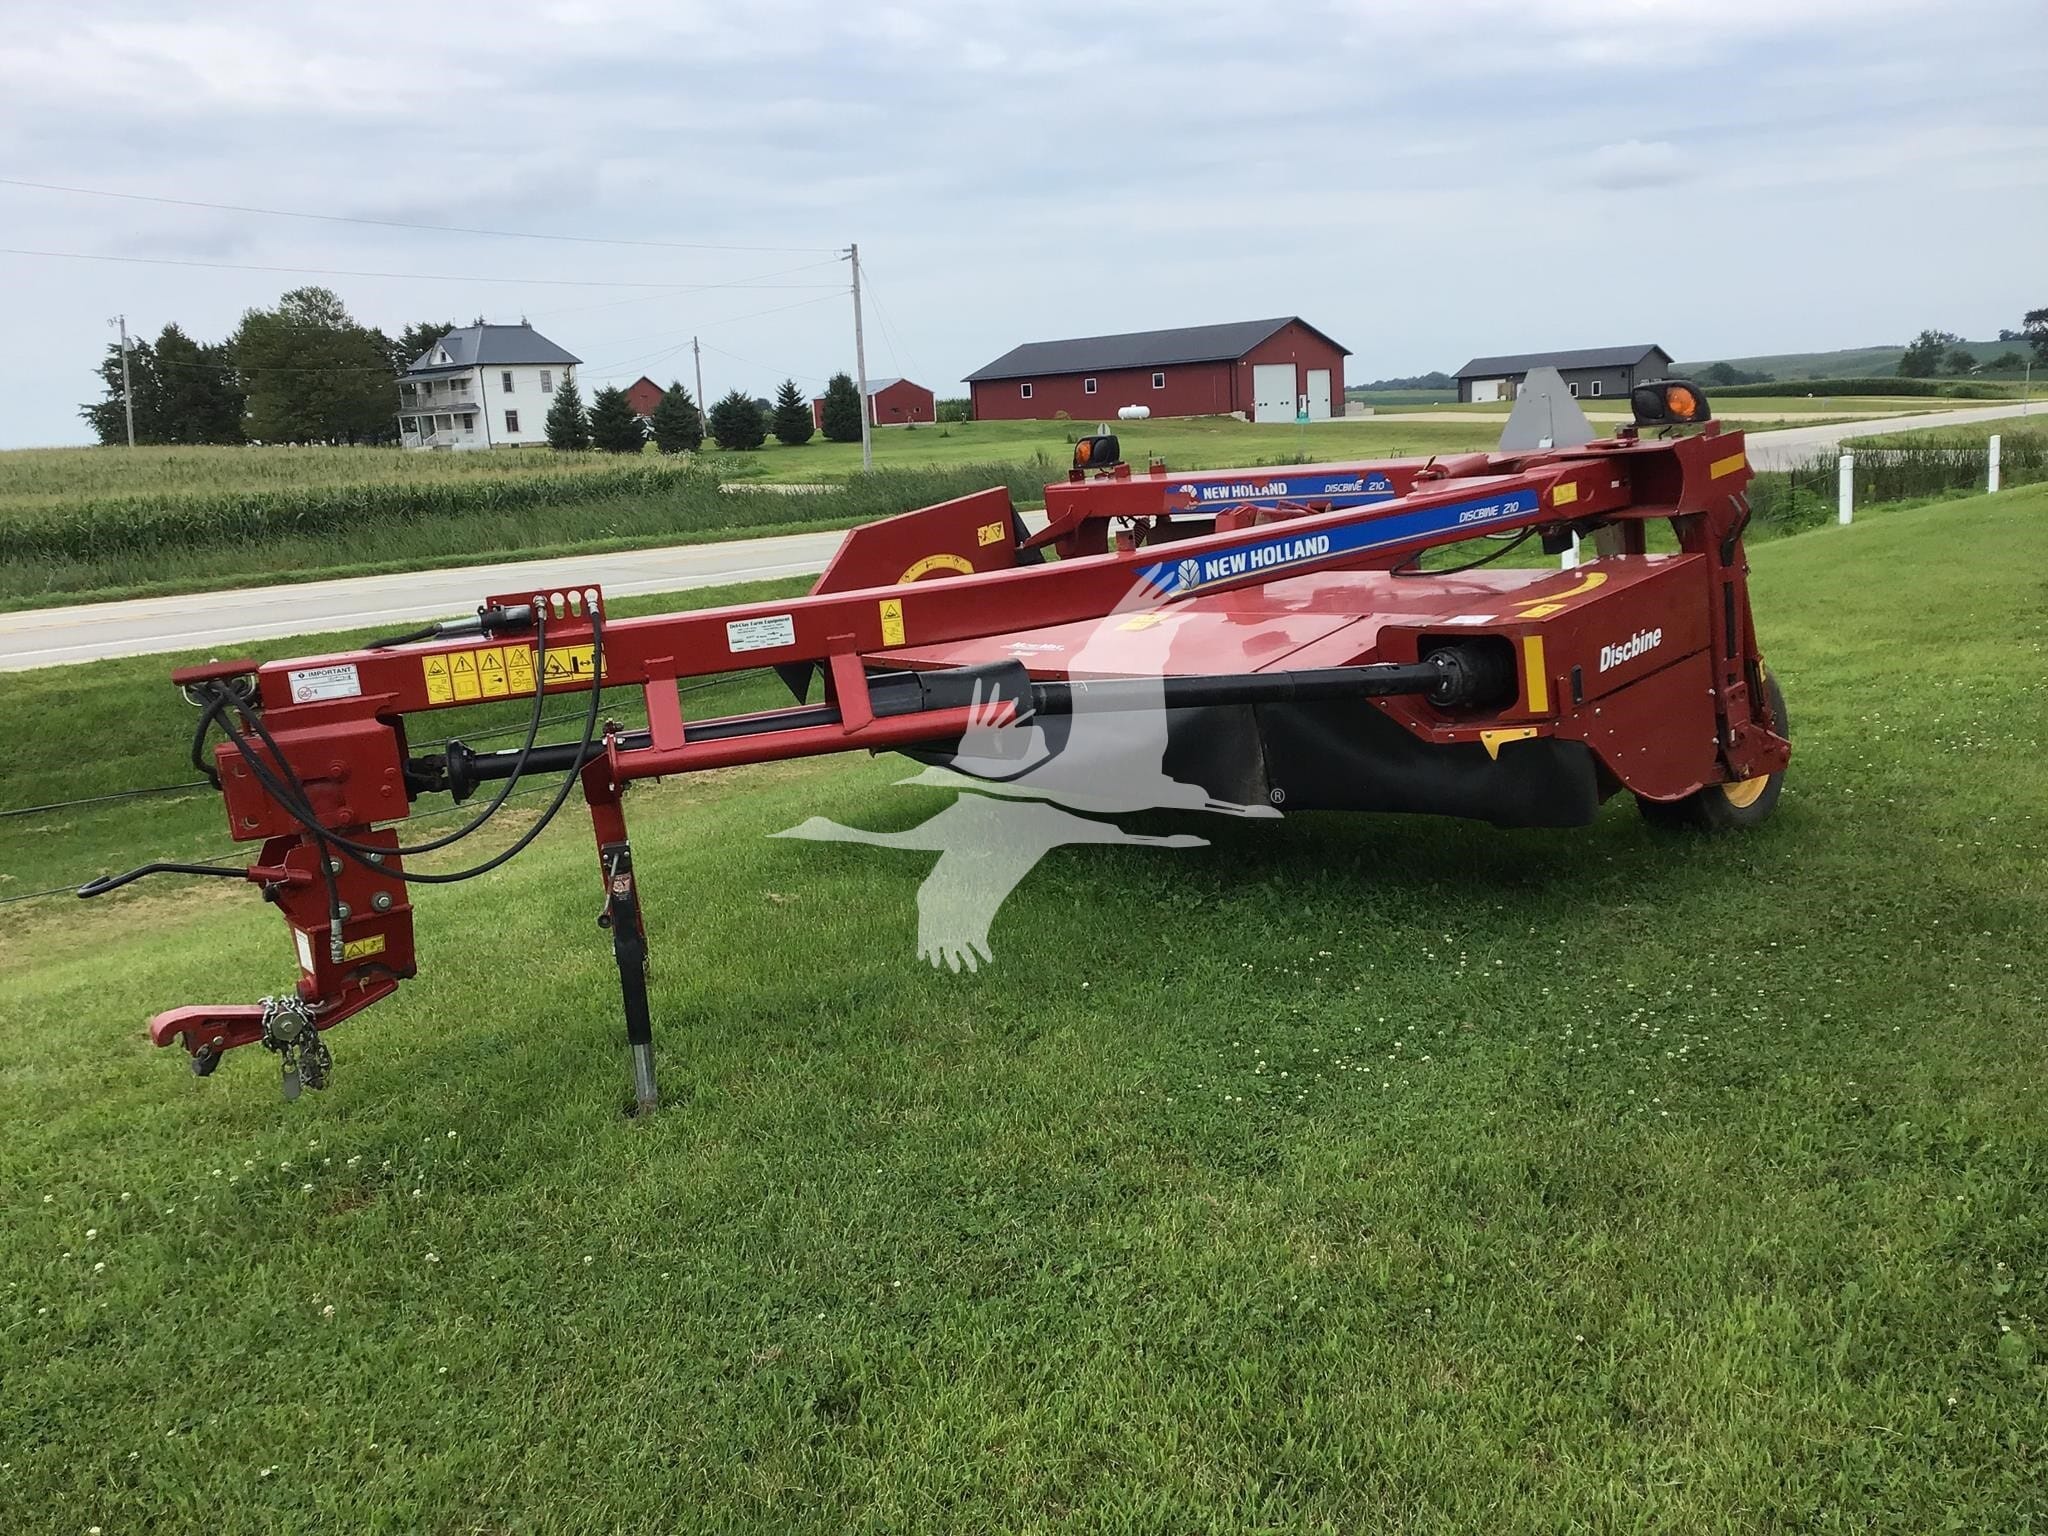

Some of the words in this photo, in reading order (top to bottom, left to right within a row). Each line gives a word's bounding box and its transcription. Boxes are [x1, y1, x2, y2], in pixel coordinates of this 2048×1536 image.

[1203, 486, 1230, 500] NEW
[1232, 482, 1288, 498] HOLLAND
[1369, 481, 1385, 491] 210
[1459, 505, 1500, 523] DISCBINE
[1503, 501, 1520, 514] 210
[1205, 552, 1247, 580] NEW
[1250, 535, 1330, 569] HOLLAND
[1600, 627, 1662, 673] Discbine
[308, 667, 351, 677] IMPORTANT
